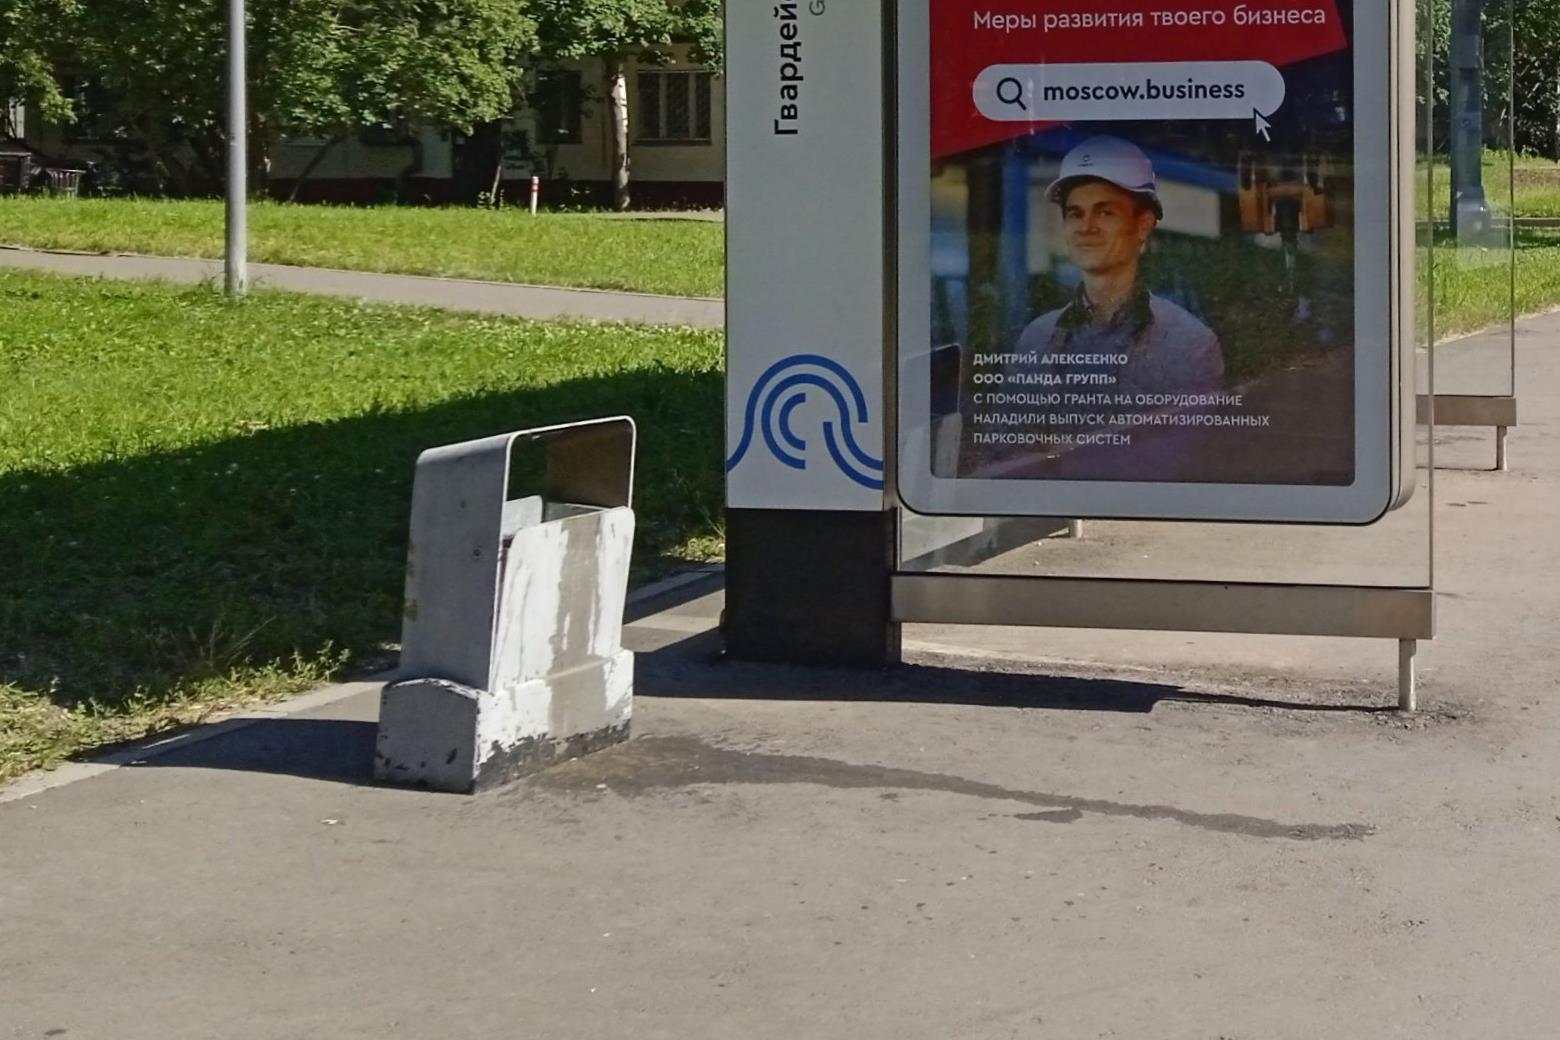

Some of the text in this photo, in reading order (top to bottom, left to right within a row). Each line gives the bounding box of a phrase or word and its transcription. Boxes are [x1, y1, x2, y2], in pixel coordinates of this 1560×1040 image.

[973, 4, 1325, 33] Меры развития твоего бизнеса
[1043, 77, 1245, 102] moscow.business
[973, 351, 1128, 365] ДМИТРИЙ АЛЕКСЕЕНКО
[973, 373, 1117, 385] ООО «ПАНДА ГРУПП»
[973, 393, 1243, 406] С ПОМОЩЬЮ ГРАНТА НА ОБОРУДОВАНИЕ
[973, 413, 1269, 426] НАЛАДИЛИ ВЫПУСК АВТОМАТИЗИРОВАННЫХ
[973, 433, 1131, 445] ПАРКОВОЧНЫХ СИСТЕМ
